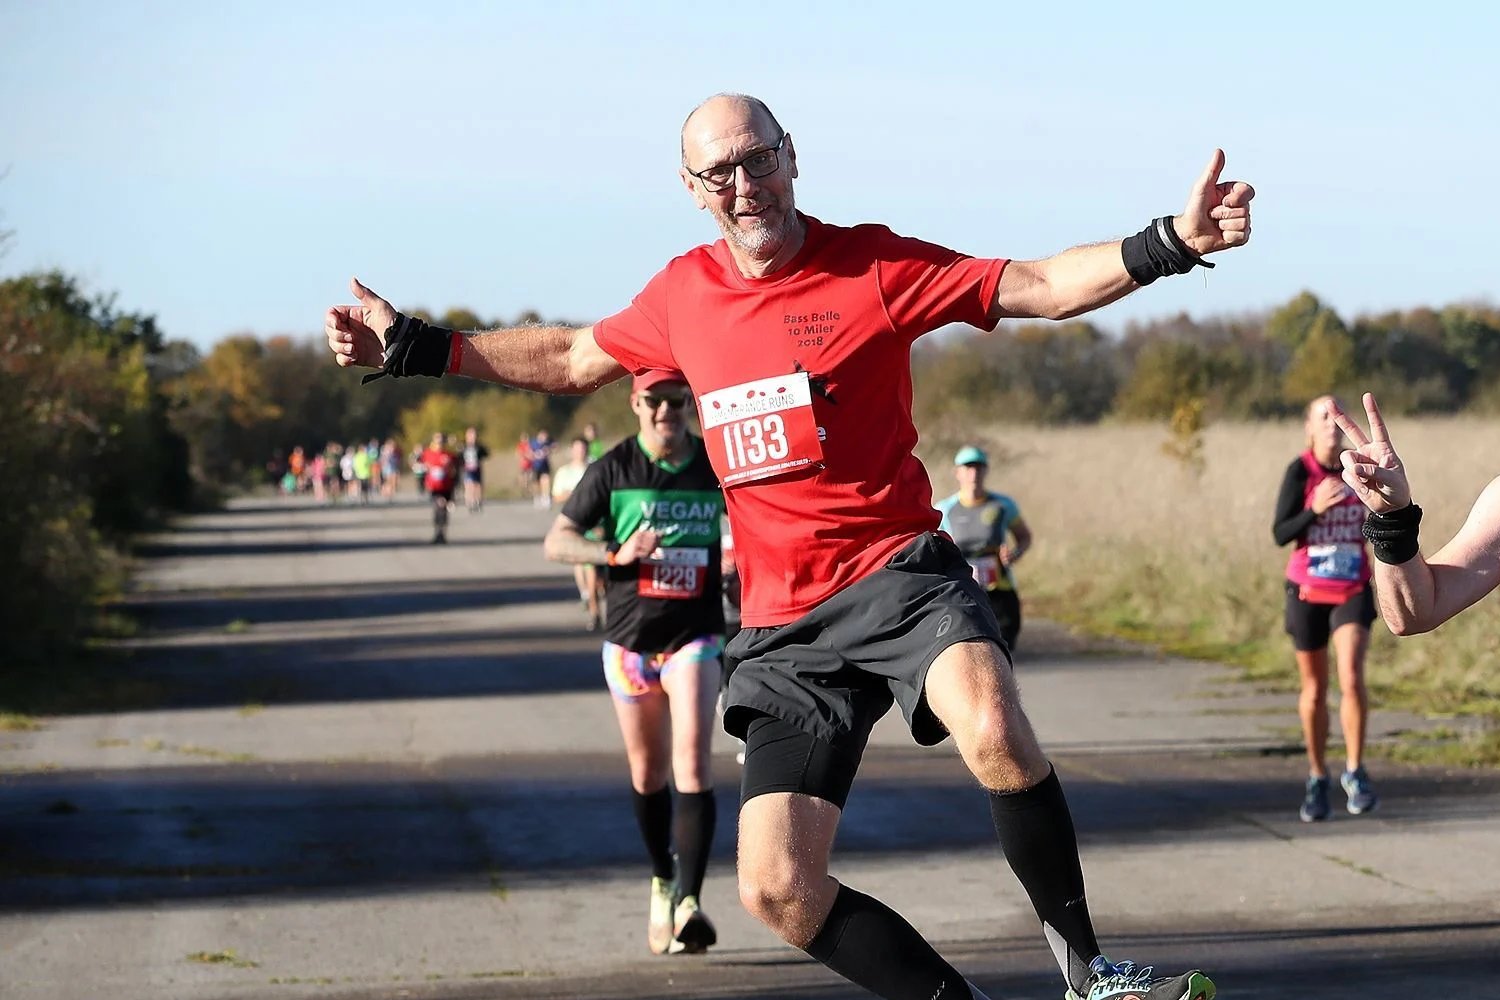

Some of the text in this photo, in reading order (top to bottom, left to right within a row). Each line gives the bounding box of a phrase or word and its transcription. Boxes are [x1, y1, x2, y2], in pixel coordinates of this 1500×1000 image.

[784, 311, 840, 323] Bass Belle
[804, 324, 834, 335] Miler
[798, 336, 823, 347] 2018
[711, 393, 795, 420] MEMBRANCE RUNS
[723, 414, 789, 470] 1133
[641, 501, 717, 519] VEGAN
[652, 566, 697, 591] 1229
